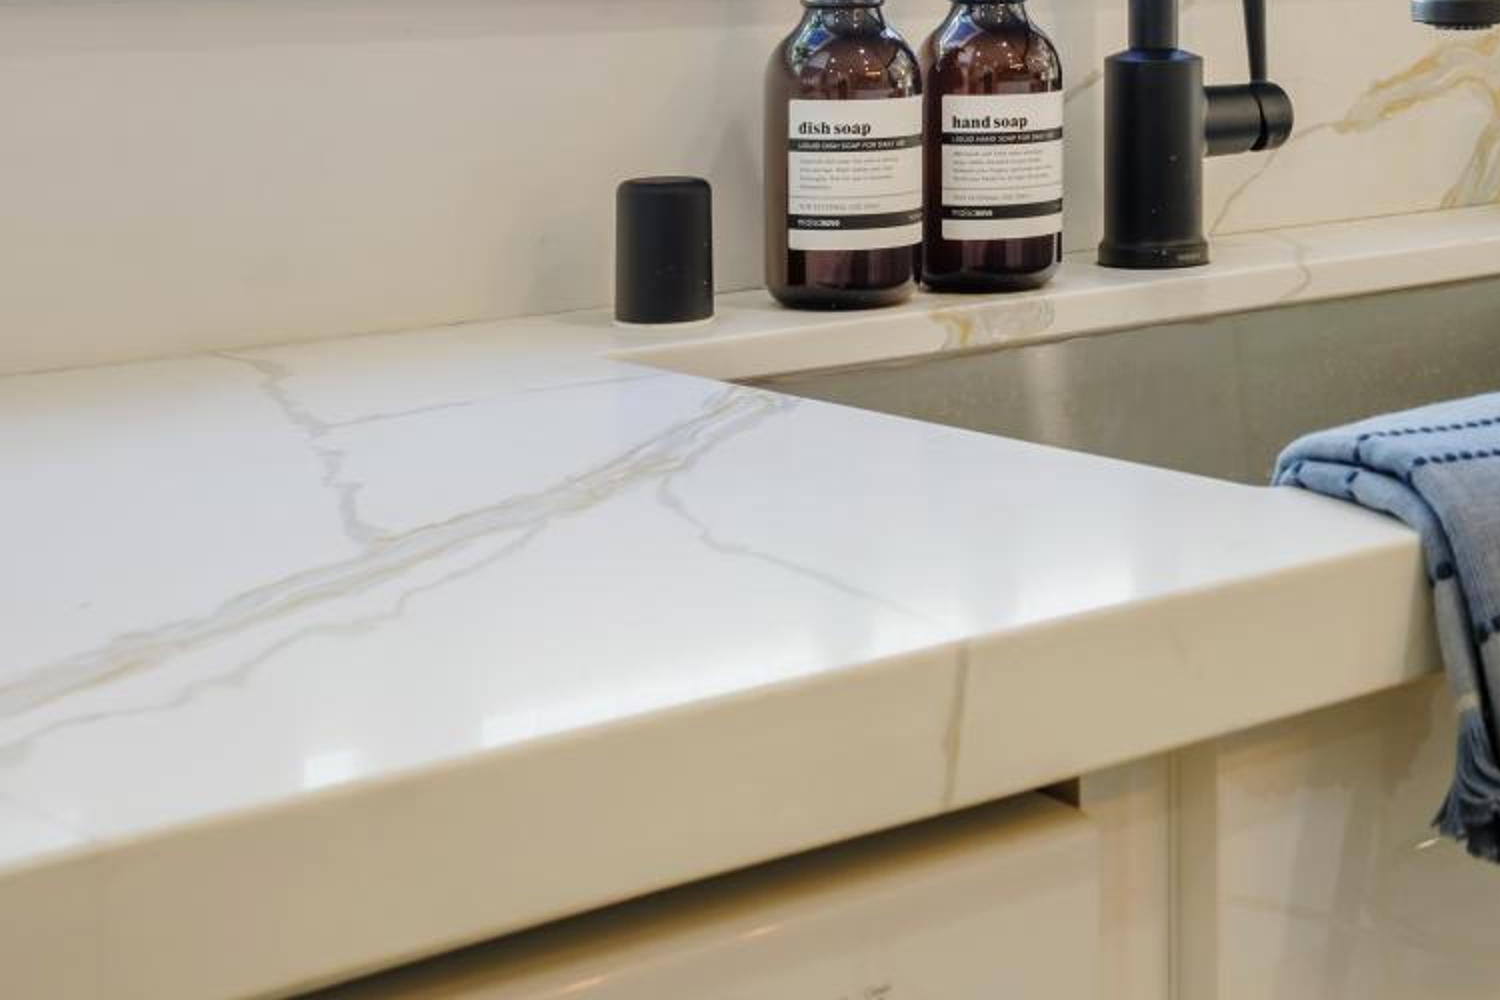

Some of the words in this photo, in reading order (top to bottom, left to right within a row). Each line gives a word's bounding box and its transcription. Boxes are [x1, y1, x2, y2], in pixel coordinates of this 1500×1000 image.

[798, 122, 831, 135] dish
[833, 123, 871, 136] soap
[952, 115, 991, 128] hand
[993, 117, 1028, 129] soap
